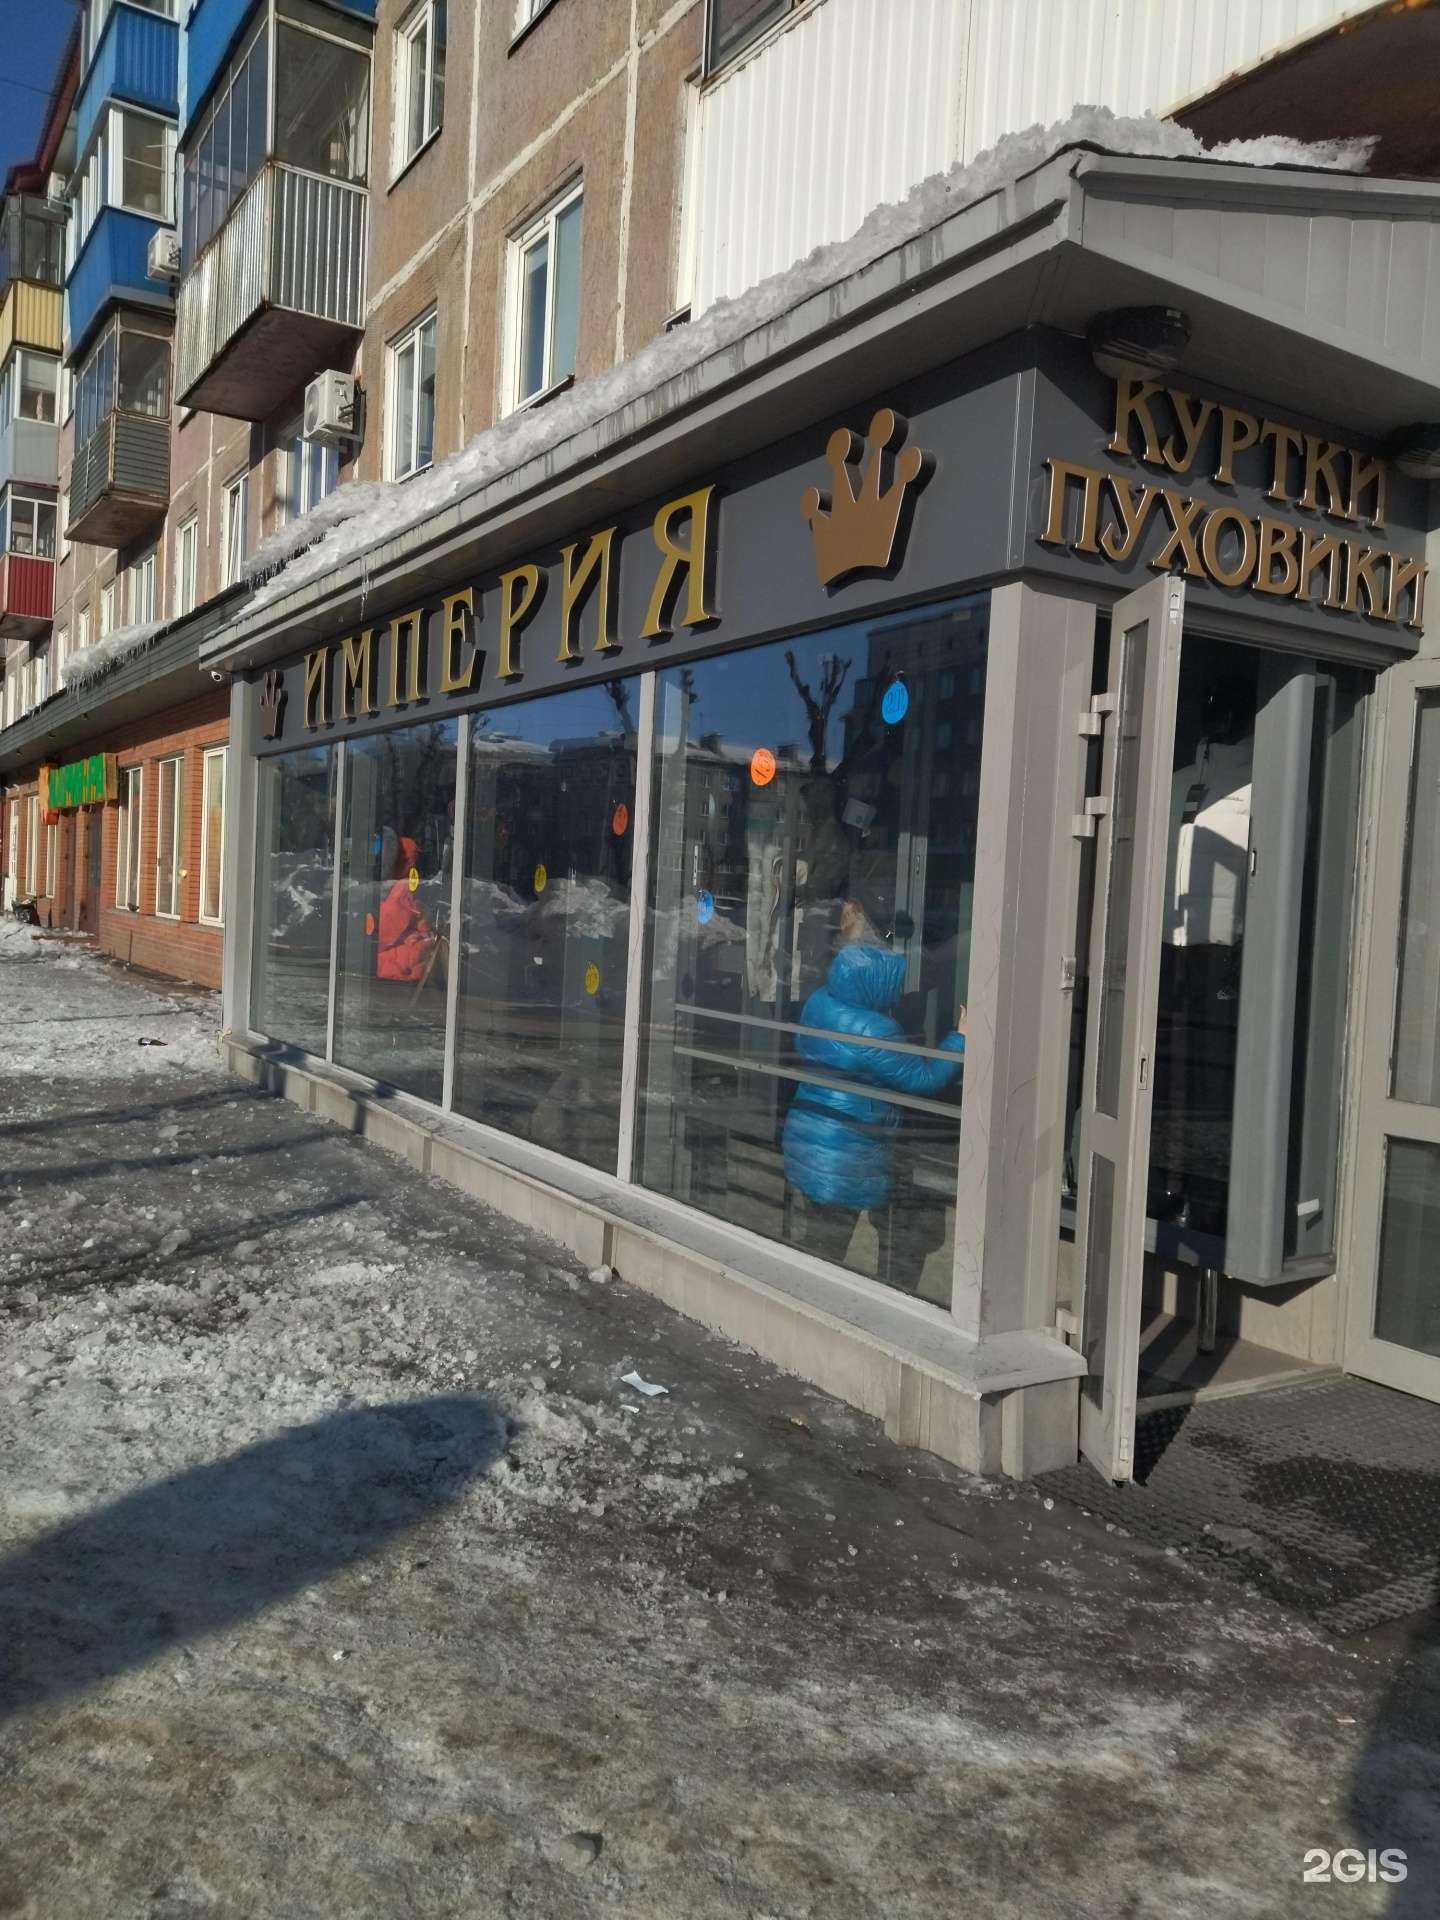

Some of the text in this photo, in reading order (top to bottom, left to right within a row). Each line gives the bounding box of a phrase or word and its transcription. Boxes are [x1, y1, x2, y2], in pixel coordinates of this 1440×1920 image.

[1104, 375, 1388, 529] КУРТКИ
[303, 484, 720, 730] ИМПЕРИЯ
[1040, 457, 1429, 629] ПУХОВИКИ
